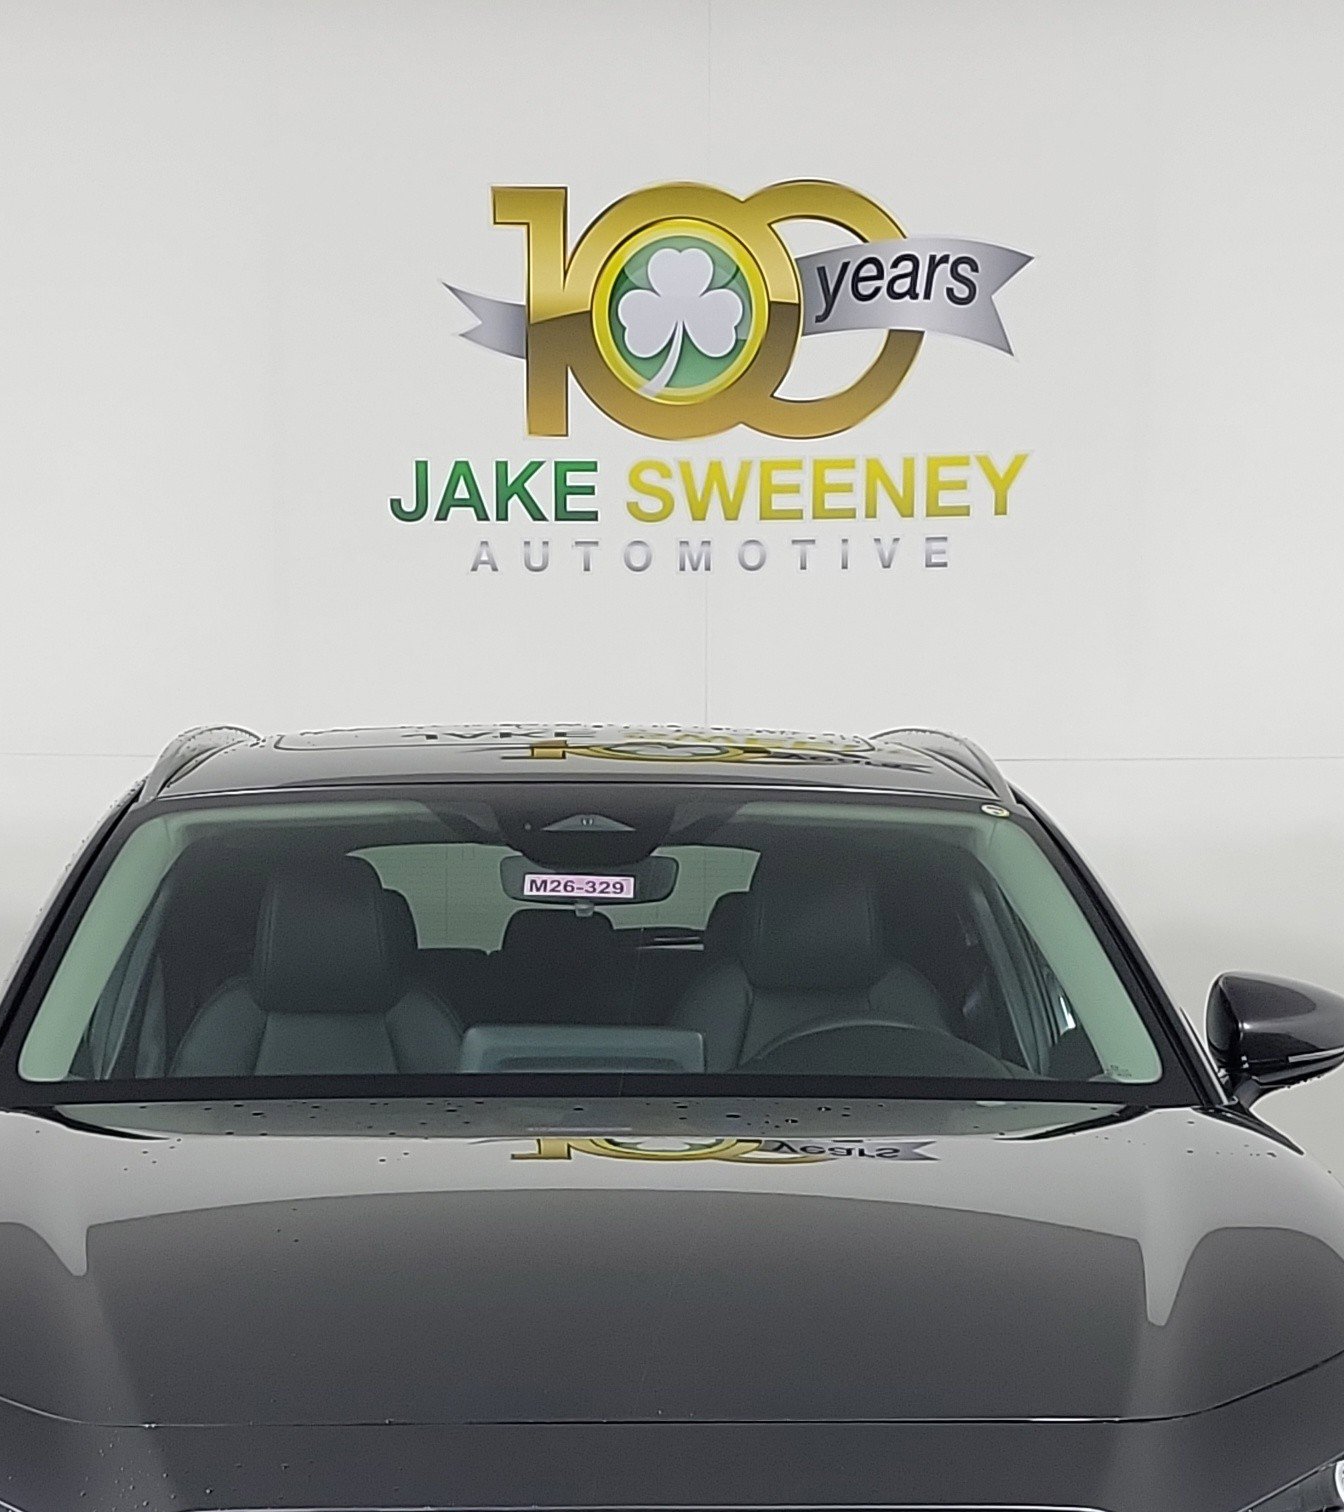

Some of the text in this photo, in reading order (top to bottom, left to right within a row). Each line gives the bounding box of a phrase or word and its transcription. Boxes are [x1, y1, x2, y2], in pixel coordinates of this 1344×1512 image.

[814, 253, 979, 323] years
[389, 453, 1029, 523] JAKE SWEENEY
[470, 536, 950, 573] AUTOMOTIVE
[529, 879, 624, 895] M26-329
